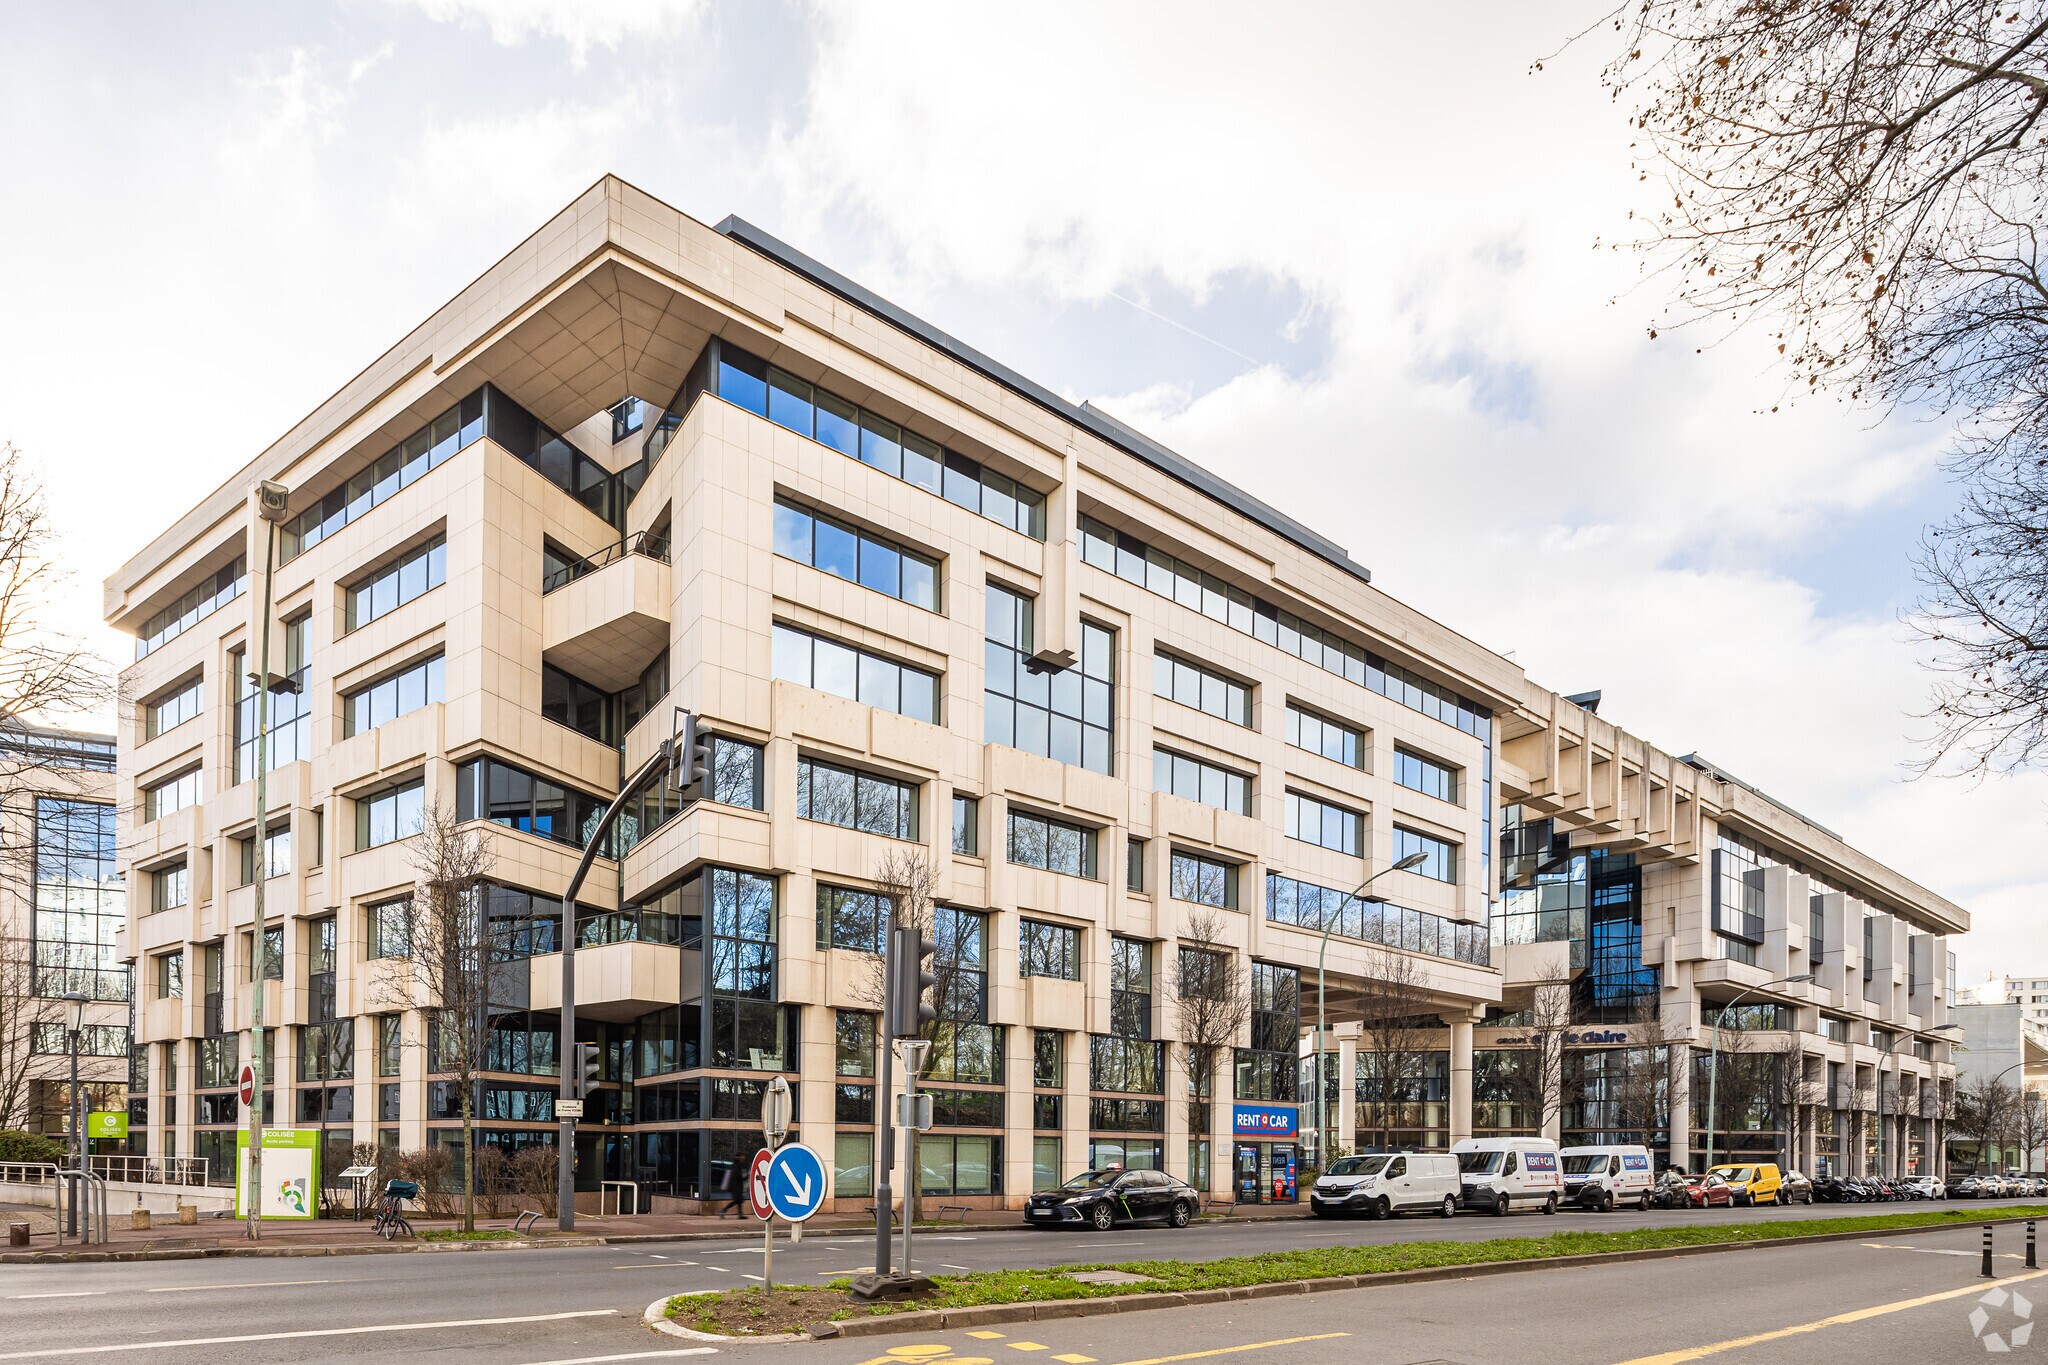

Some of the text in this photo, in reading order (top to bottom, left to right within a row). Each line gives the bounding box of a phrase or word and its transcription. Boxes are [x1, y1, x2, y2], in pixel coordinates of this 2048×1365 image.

[1582, 1029, 1627, 1043] claire
[1237, 1113, 1288, 1128] RENT a CAR
[1527, 1156, 1540, 1166] RENT
[1544, 1156, 1555, 1166] CAR
[1624, 1158, 1635, 1166] RENT
[1638, 1158, 1646, 1166] CAR
